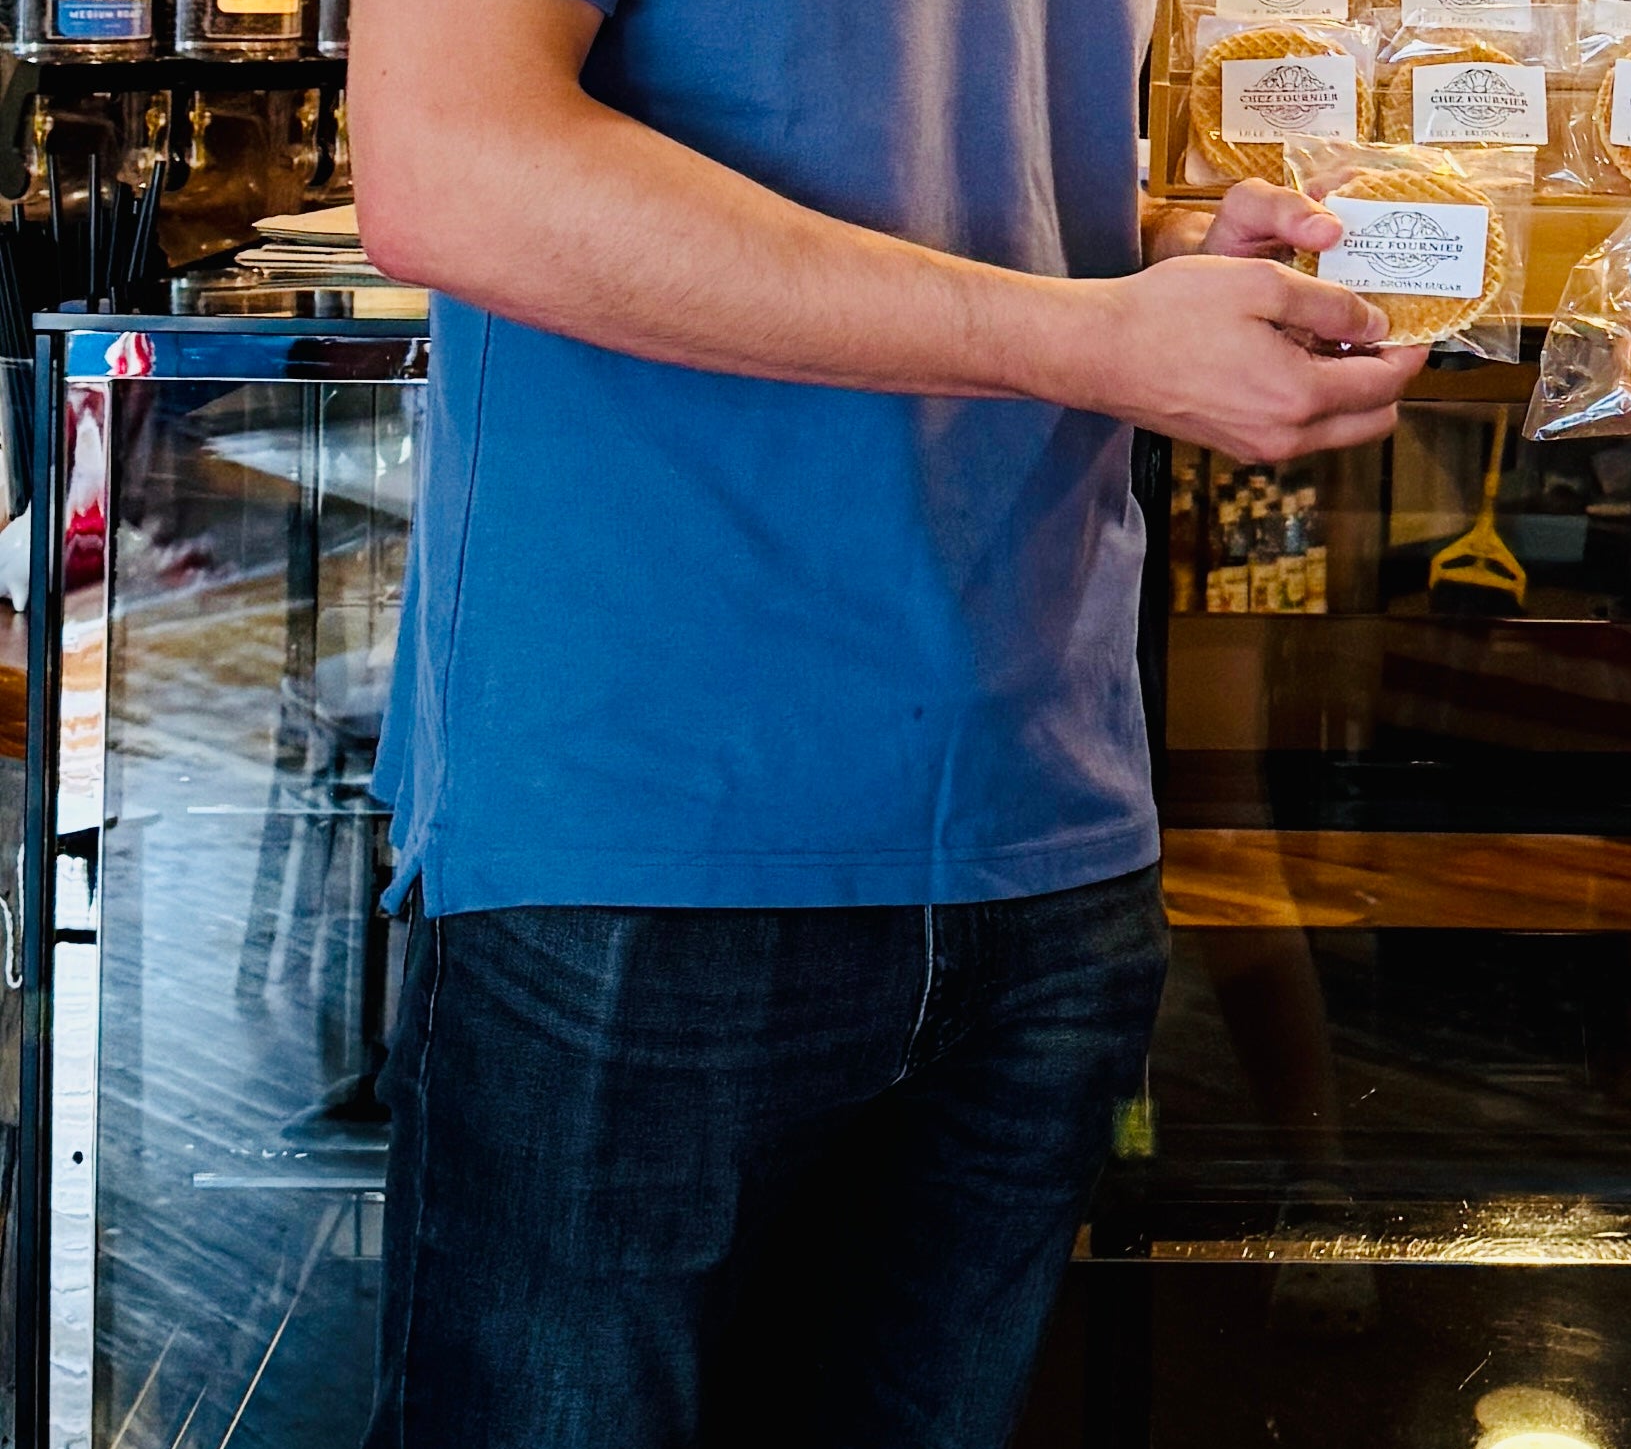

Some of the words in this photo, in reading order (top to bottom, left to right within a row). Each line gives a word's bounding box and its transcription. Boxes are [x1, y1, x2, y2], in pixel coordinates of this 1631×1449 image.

[1430, 94, 1462, 105] CHEZ
[1466, 96, 1529, 108] FOURNIER
[1343, 238, 1383, 251] CHEZ
[1387, 241, 1464, 254] FOURNIER
